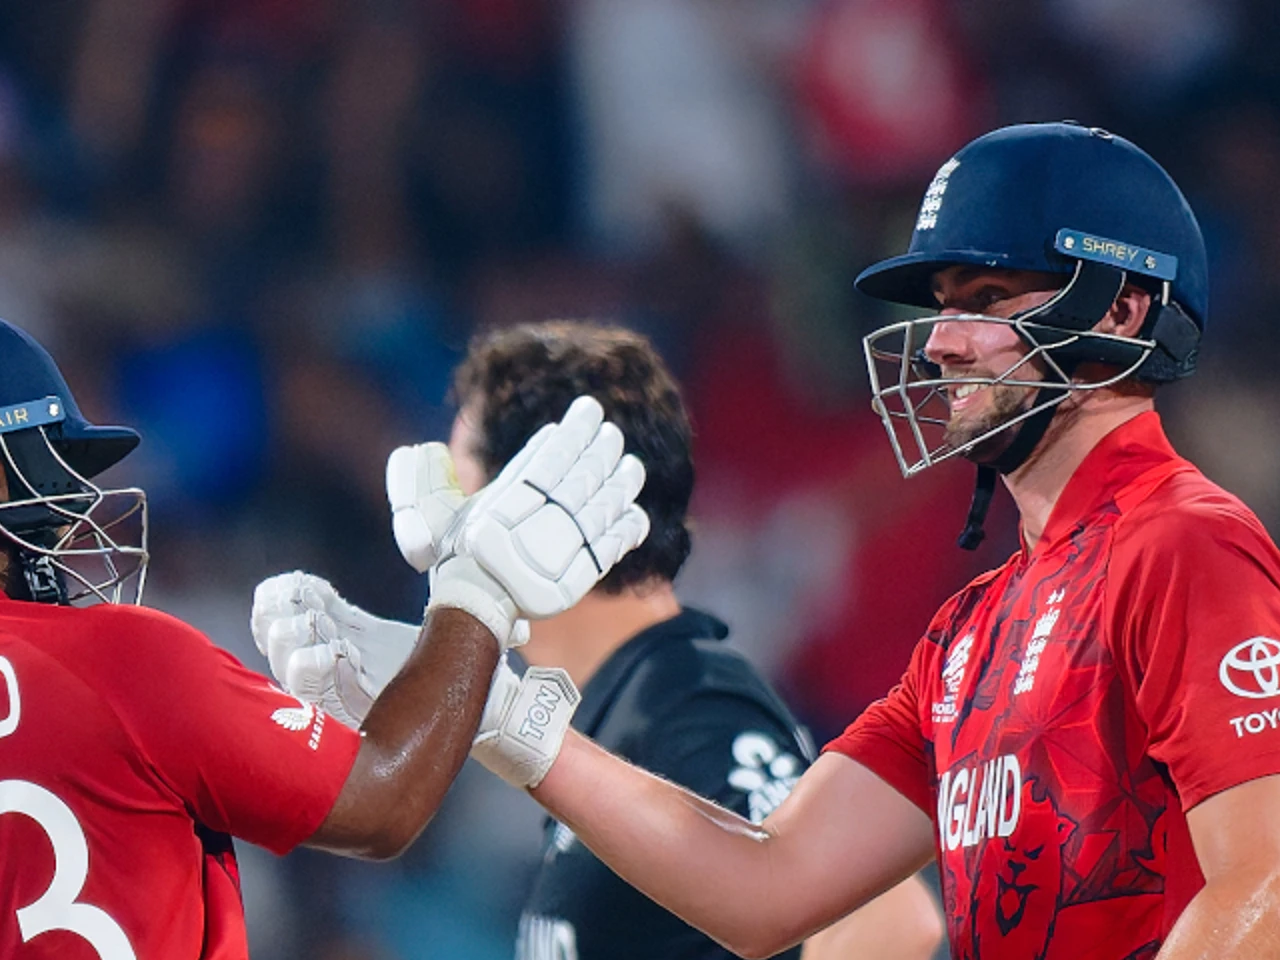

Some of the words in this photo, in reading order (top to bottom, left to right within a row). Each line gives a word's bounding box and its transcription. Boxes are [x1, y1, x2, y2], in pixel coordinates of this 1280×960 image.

[1083, 237, 1139, 261] SHREY
[518, 684, 561, 741] TON
[937, 753, 1021, 853] NGLAND
